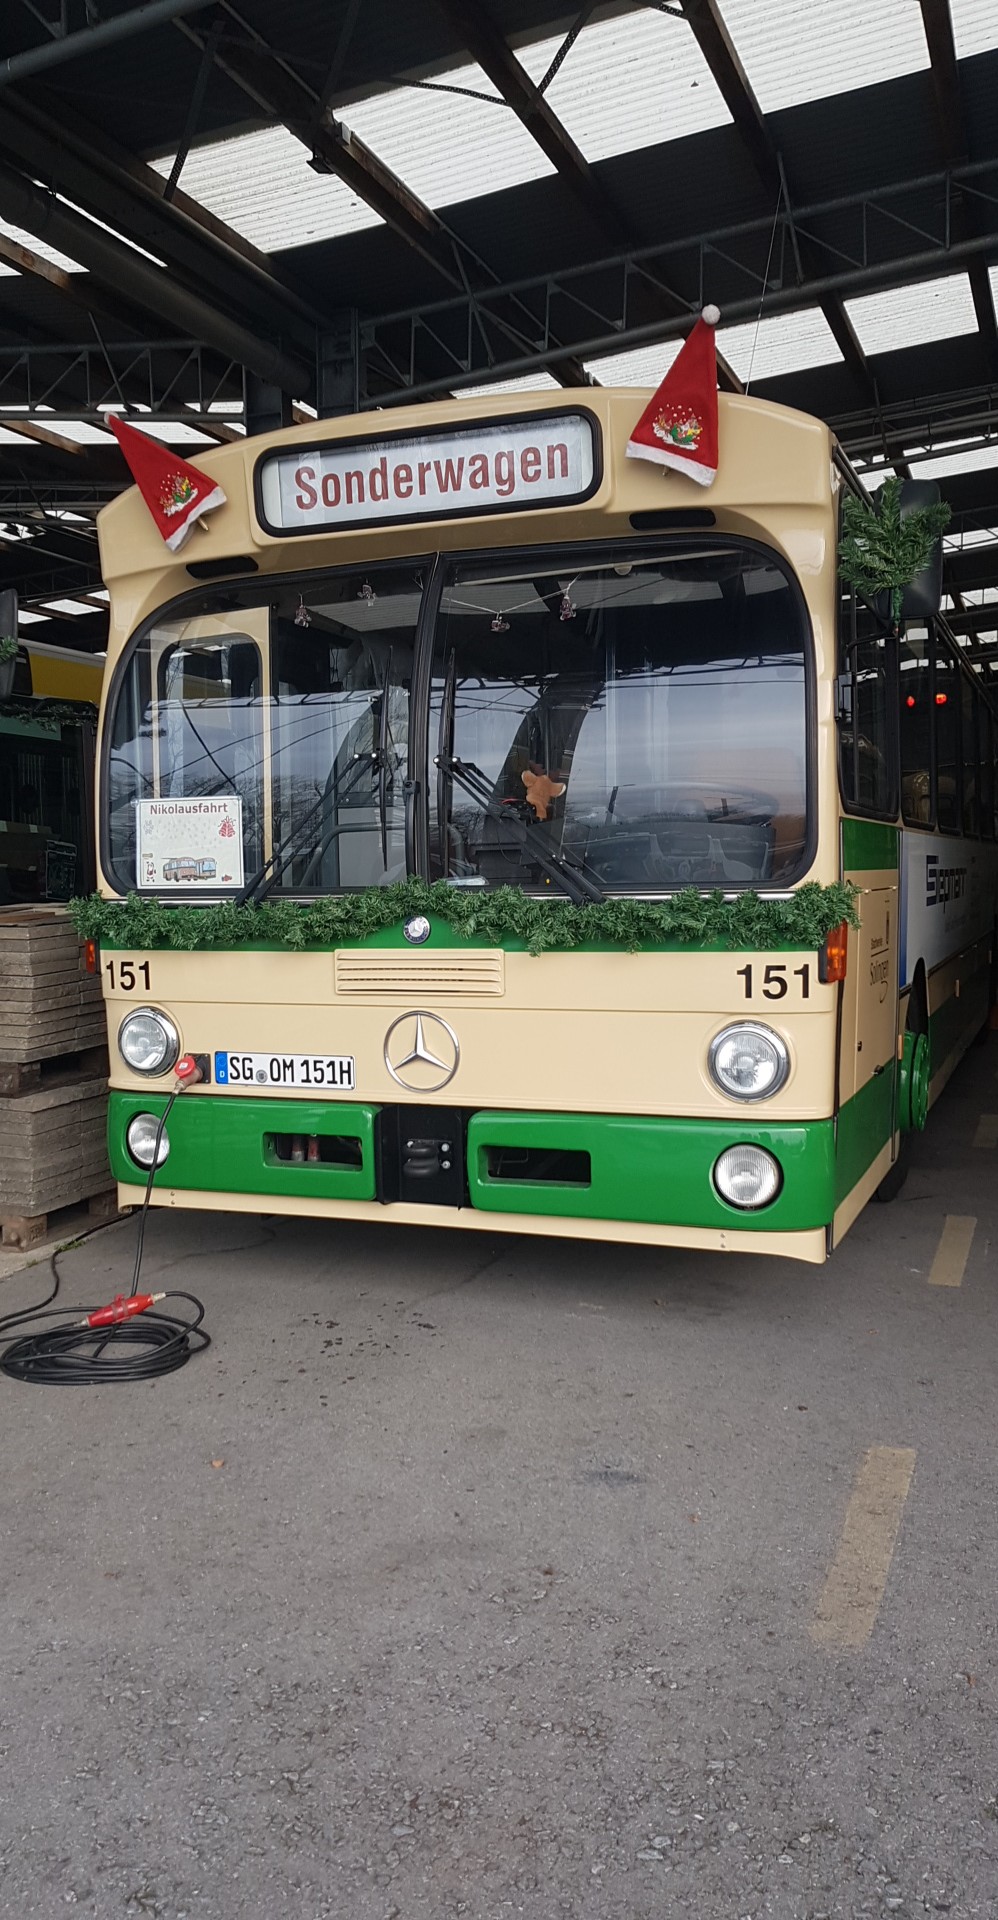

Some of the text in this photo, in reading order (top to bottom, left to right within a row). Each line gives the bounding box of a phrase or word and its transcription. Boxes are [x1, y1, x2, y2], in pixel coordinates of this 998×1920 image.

[294, 443, 569, 510] Sonderwagen
[150, 802, 228, 815] Nikolausfahrt
[106, 960, 151, 991] 151
[736, 963, 810, 1000] 151
[229, 1056, 352, 1085] SG OM 151H
